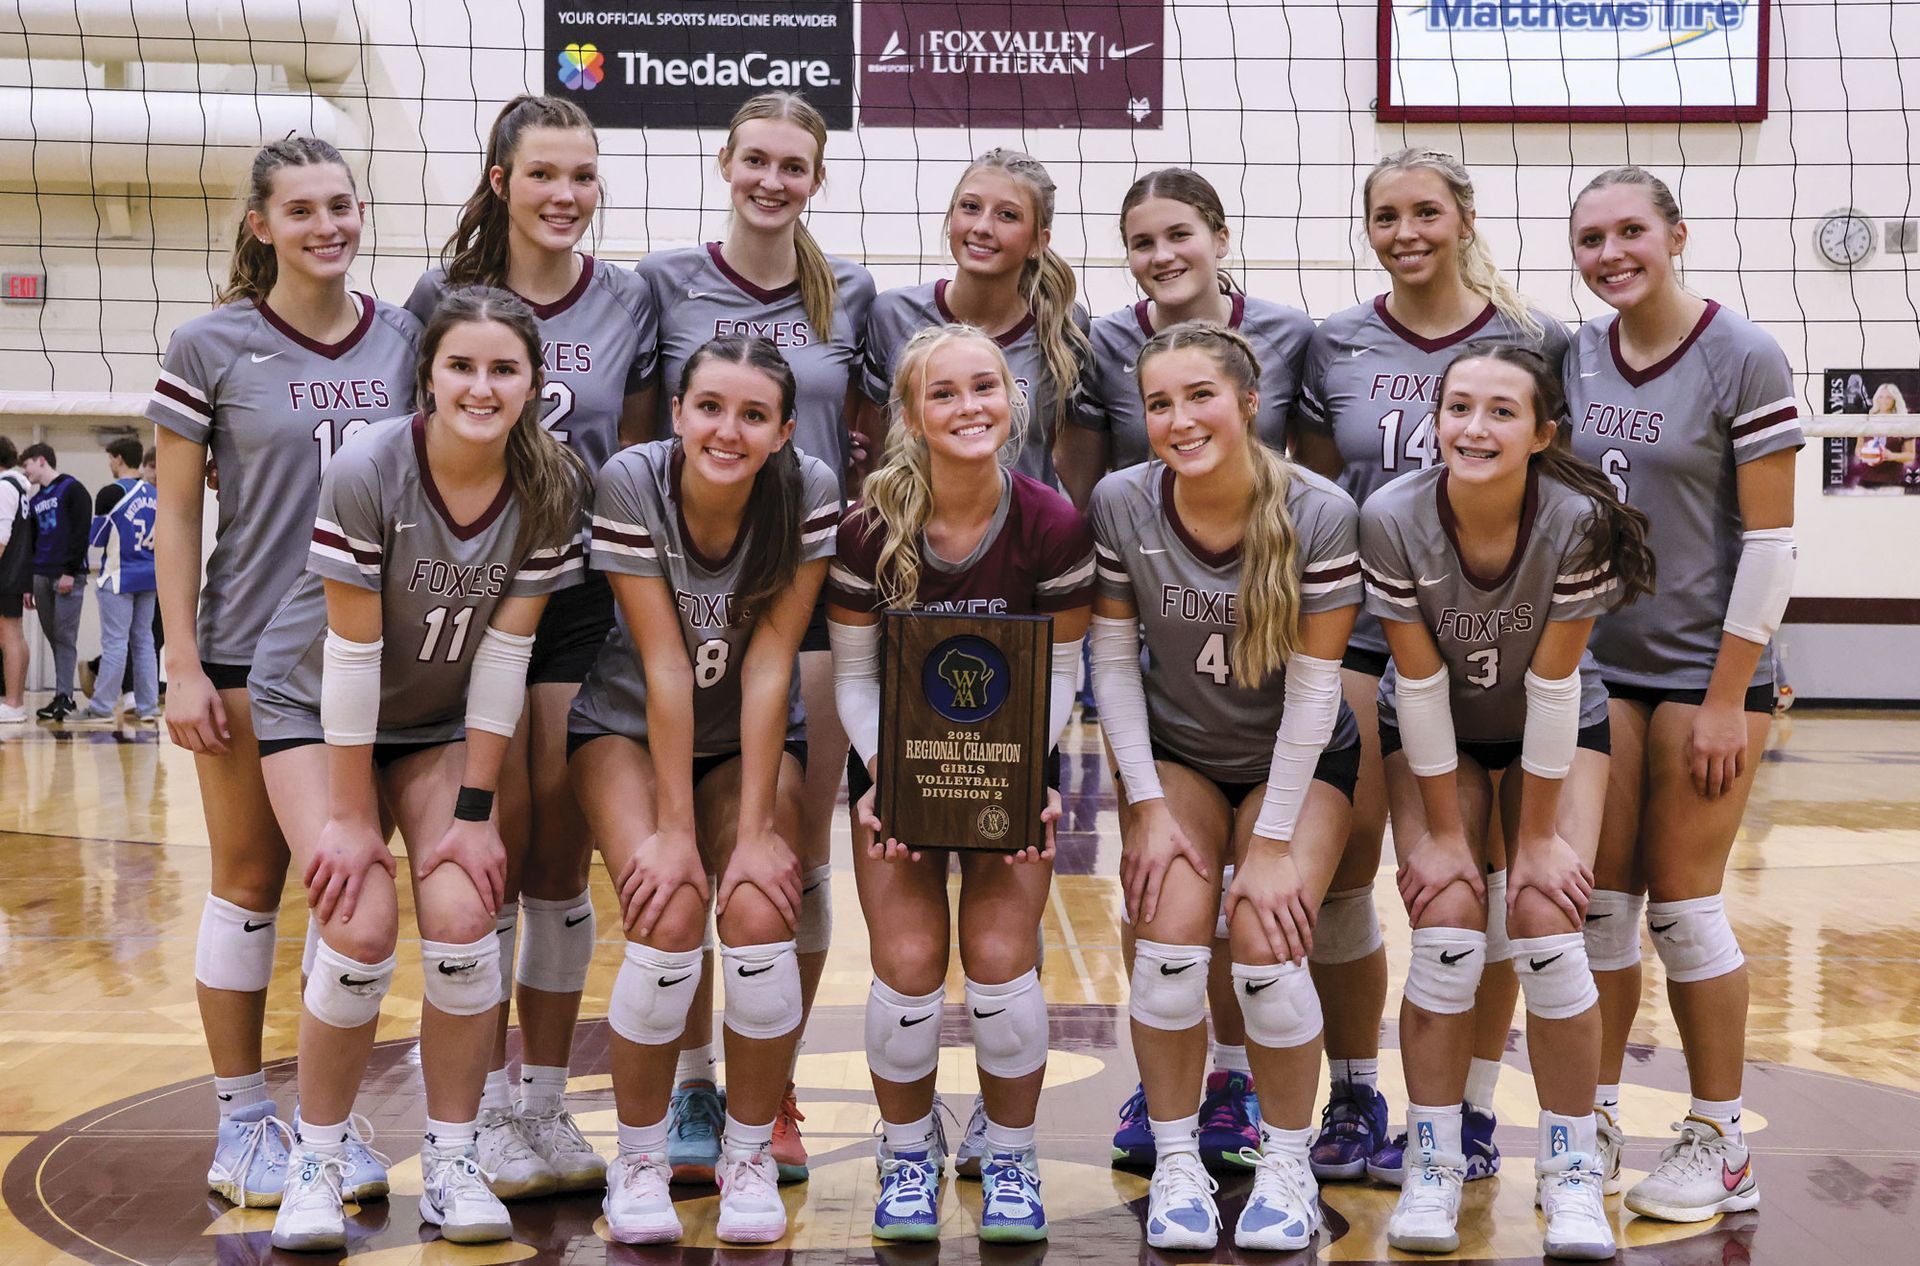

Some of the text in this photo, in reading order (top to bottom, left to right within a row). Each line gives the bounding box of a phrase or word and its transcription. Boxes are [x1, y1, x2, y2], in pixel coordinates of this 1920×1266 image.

[558, 12, 837, 27] YOUR OFFICIAL SPORTS MEDICINE PROVIDER
[1427, 0, 1651, 30] Matthews
[928, 30, 1096, 53] FOX VALLEY
[617, 52, 831, 87] ThedaCare
[931, 53, 1090, 75] LUTHERAN
[10, 274, 37, 298] EXIT
[288, 379, 390, 411] FOXES
[1378, 409, 1440, 472] 14
[1580, 401, 1664, 445] FOXES
[312, 418, 370, 484] 1
[1831, 437, 1843, 485] ELLIE
[407, 558, 508, 599] FOXES
[1161, 583, 1239, 626] FOXE
[1436, 602, 1533, 642] FOXES
[416, 605, 473, 663] 11
[694, 637, 730, 690] 8
[1194, 631, 1233, 686] 4
[1465, 646, 1500, 690] 3
[905, 739, 1021, 763] REGIONAL CHAMPION
[947, 731, 981, 741] 2025
[916, 774, 1009, 788] VOLLEYBALL
[940, 763, 985, 774] GIRLS
[922, 787, 1003, 800] DIVISION 2
